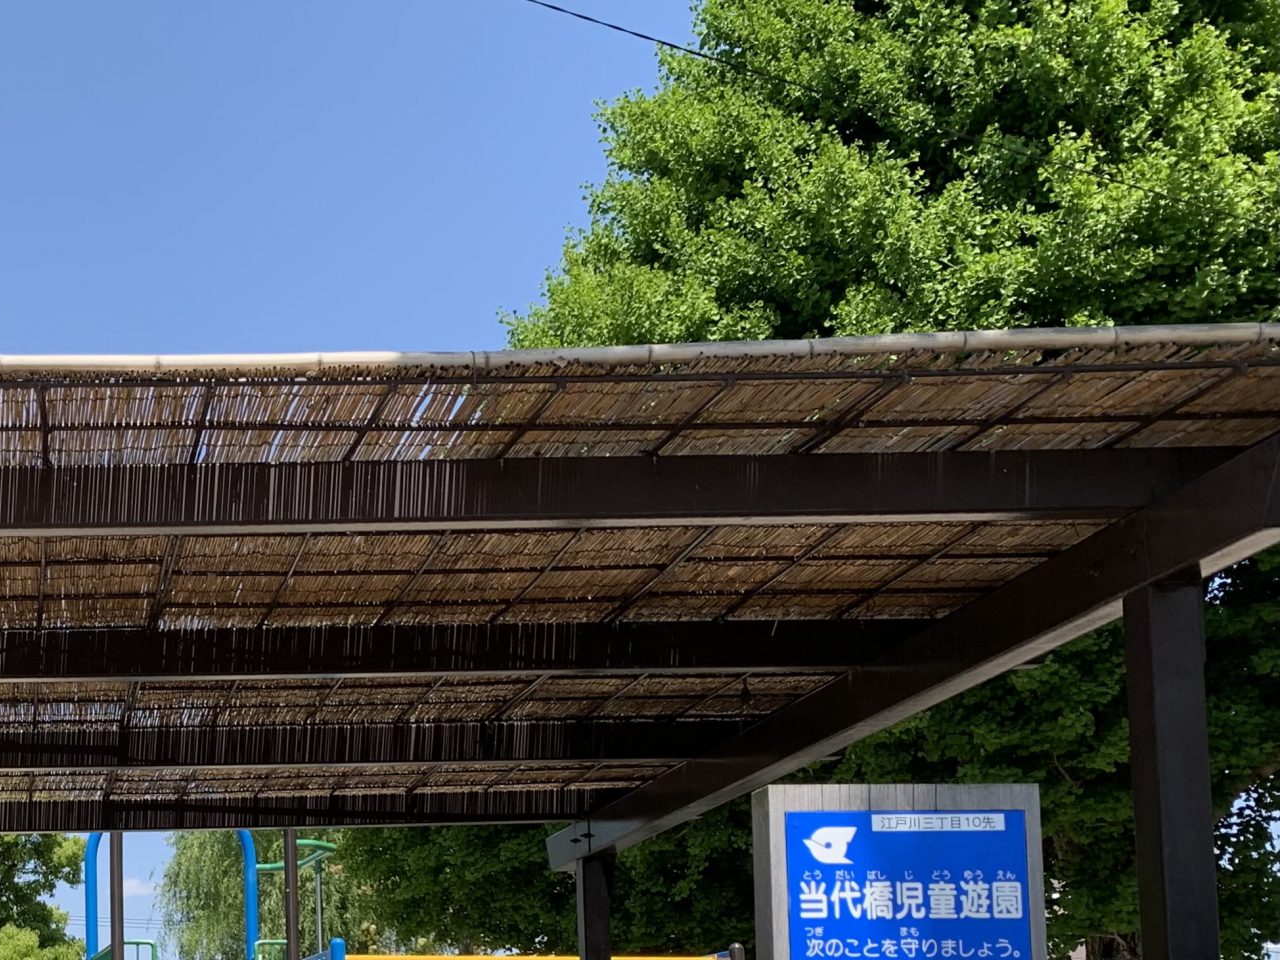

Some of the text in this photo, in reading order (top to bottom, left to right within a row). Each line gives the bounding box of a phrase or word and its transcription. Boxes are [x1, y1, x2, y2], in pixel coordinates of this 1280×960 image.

[880, 815, 996, 830] 江戸川三丁目10先
[799, 880, 1023, 920] 当代橋児童遊園
[804, 926, 919, 937] つぎ まも
[805, 938, 1021, 958] 次のことを守りましょう。
